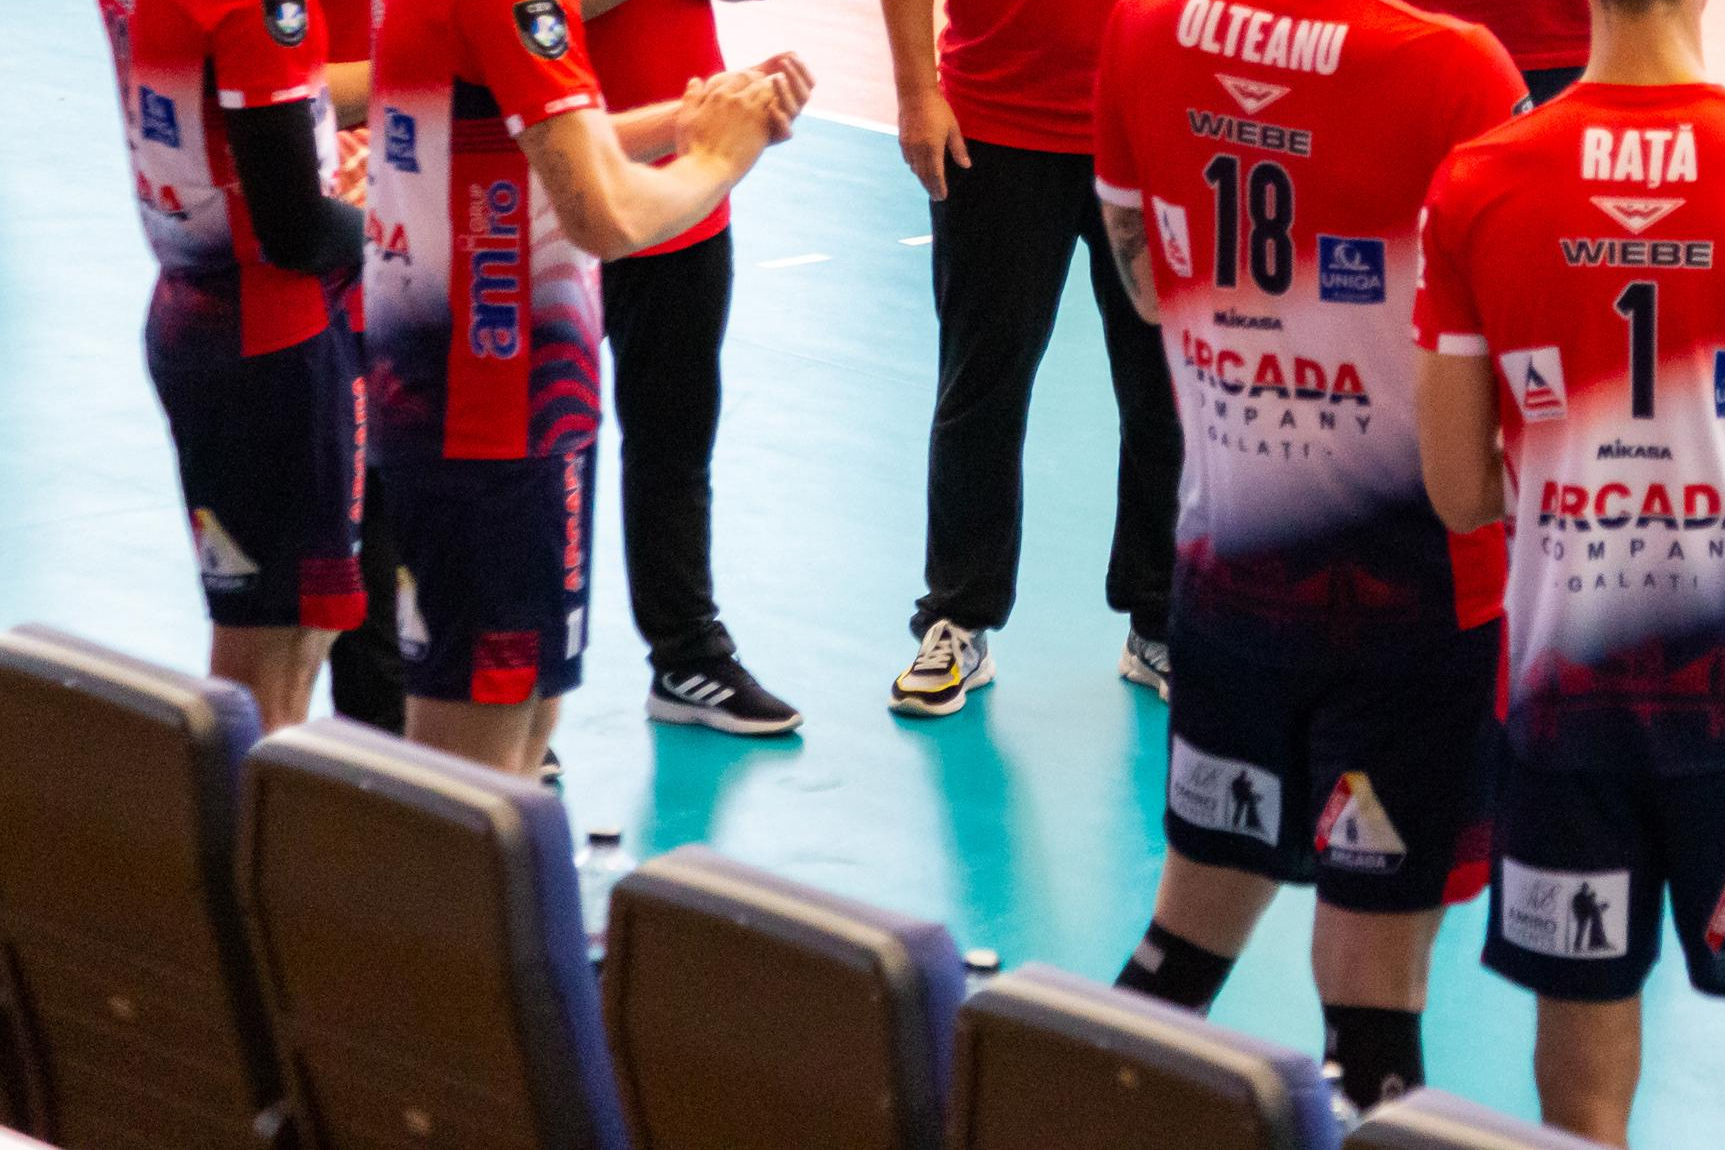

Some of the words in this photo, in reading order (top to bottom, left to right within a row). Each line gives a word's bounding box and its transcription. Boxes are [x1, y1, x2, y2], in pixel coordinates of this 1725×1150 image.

[1186, 107, 1312, 157] WIEBE
[455, 179, 521, 359] amiro
[1203, 154, 1295, 297] 18
[1559, 237, 1714, 270] WIEBE
[1321, 271, 1383, 290] UNIQA
[1613, 280, 1658, 420] 1
